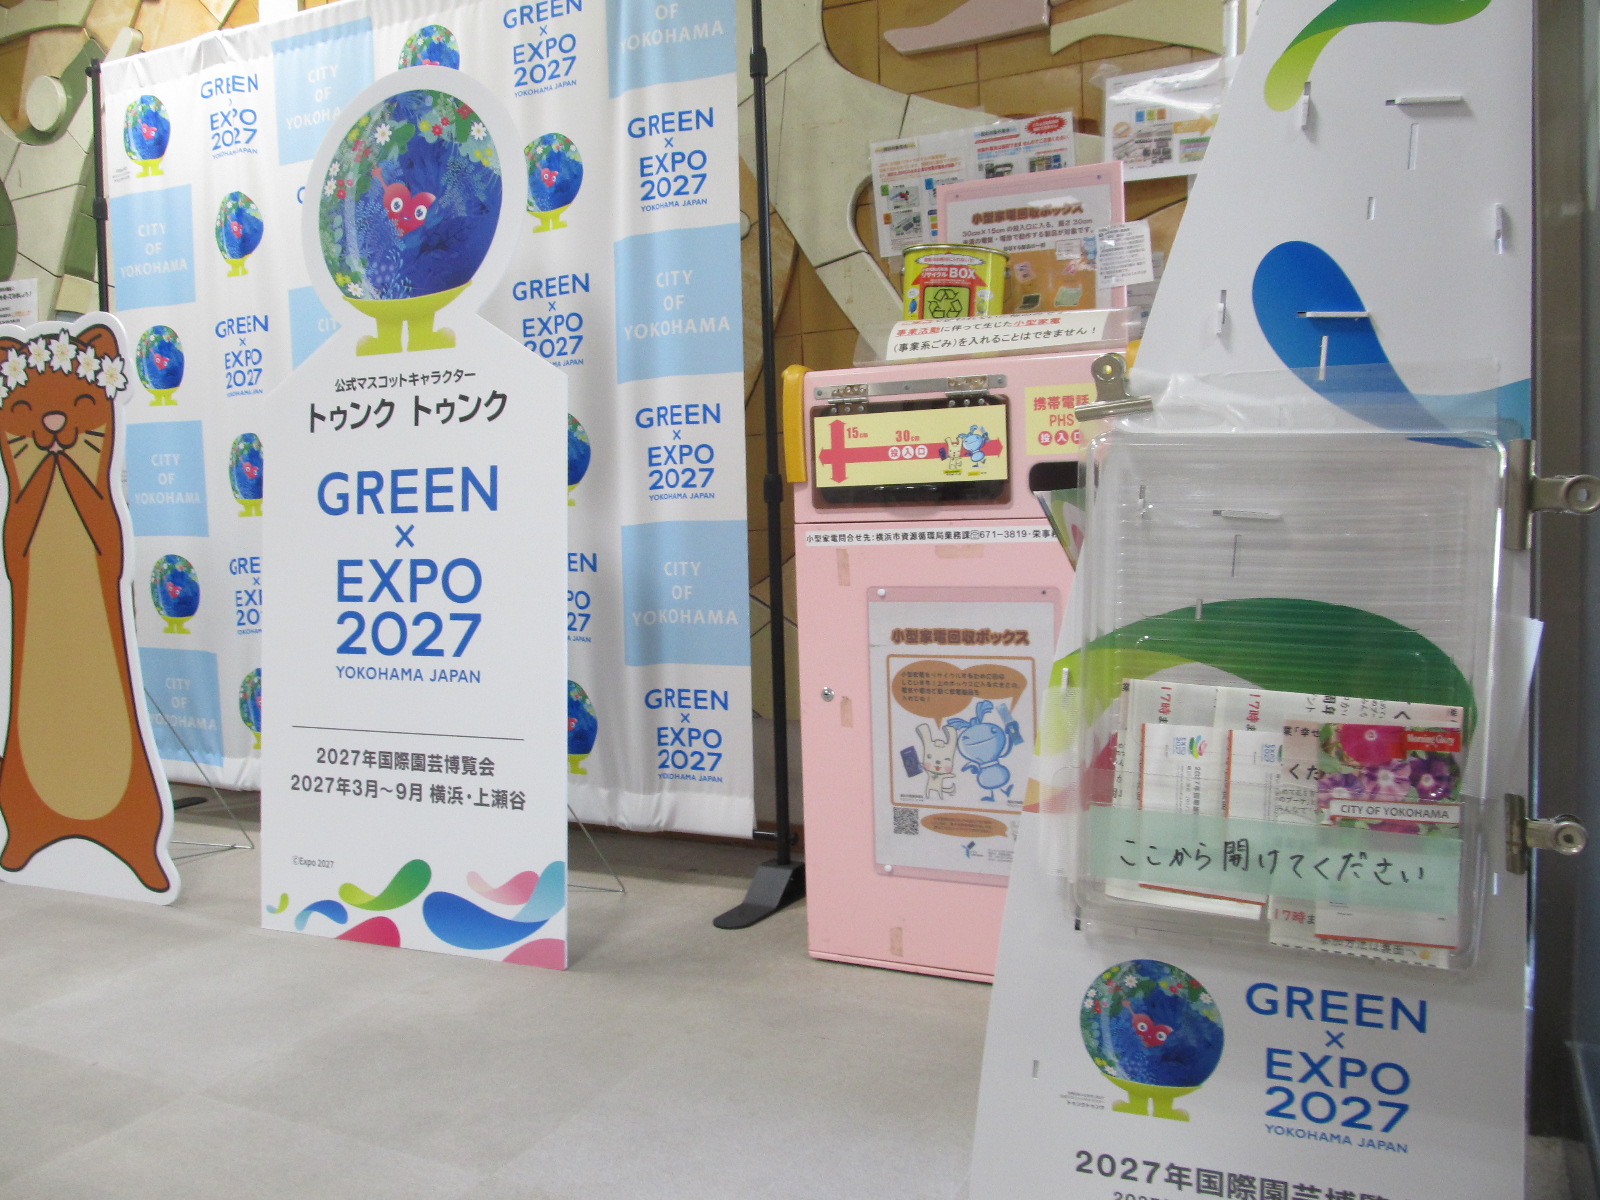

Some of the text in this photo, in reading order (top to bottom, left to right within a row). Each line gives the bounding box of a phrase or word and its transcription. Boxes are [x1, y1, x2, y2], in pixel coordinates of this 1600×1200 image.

[503, 0, 582, 29] GREEN
[655, 3, 679, 20] OF
[619, 19, 725, 54] YOKOHAMA
[513, 33, 577, 65] EXPO
[307, 64, 339, 83] CITY
[514, 55, 577, 87] 2027
[201, 73, 258, 99] GREEN
[315, 86, 332, 102] OF
[514, 80, 577, 98] YOKOHAMA JAPAN
[285, 106, 342, 130] YOKOHA
[627, 107, 715, 138] GREEN
[639, 149, 708, 178] EXPO
[640, 173, 708, 201] 2027
[640, 198, 708, 212] YOKOHAMA JAPAN
[137, 221, 167, 238] CITY
[144, 242, 162, 256] OF
[119, 260, 188, 279] YOKOHAMA
[655, 270, 693, 288] CITY
[949, 267, 977, 279] BOX
[512, 272, 590, 301] GREEN
[663, 294, 685, 311] OF
[215, 314, 269, 338] GREEN
[318, 317, 337, 332] CIT
[522, 312, 584, 338] EXPO
[624, 316, 731, 341] YOKOHAMA
[225, 348, 263, 369] EXPO
[563, 359, 584, 367] JAPAN
[226, 368, 263, 389] 2027
[334, 369, 477, 393] 公式マスコットキャラクター
[310, 389, 508, 433] トゥンク トゥンク
[1034, 394, 1090, 411] 携帯電話
[635, 403, 721, 429] GREEN
[1049, 413, 1075, 427] PHS
[846, 426, 869, 439] 15cm
[895, 429, 920, 443] 30cm
[151, 453, 181, 466] CITY
[648, 443, 715, 467] EXPO
[889, 446, 927, 459] 投入口
[158, 473, 176, 485] OF
[648, 467, 715, 491] 2027
[135, 492, 200, 505] YOKOHAMA
[317, 465, 498, 516] GREEN
[648, 492, 715, 501] YOKOHAMA JAPAN
[229, 556, 261, 575] GRE
[663, 561, 702, 577] CITY
[337, 557, 483, 604] EXPO
[671, 585, 693, 600] OF
[236, 608, 262, 626] 20
[567, 612, 591, 632] 27
[632, 608, 739, 626] YOKOHAMA
[336, 611, 482, 658] 2027
[891, 627, 1030, 646] 小型家電回収ボックス
[166, 677, 191, 690] CITY
[335, 665, 481, 684] YOKOHAMA JAPAN
[171, 696, 188, 708] OF
[644, 688, 729, 711] GREEN
[657, 727, 722, 749] EXPO
[316, 747, 495, 778] 2027年国際園芸博覧会
[657, 749, 723, 772] 2027
[698, 775, 723, 783] JAPAN
[1340, 804, 1449, 819] CITY OF YOKOHAMA
[317, 858, 334, 869] 2027
[1119, 838, 1424, 886] ここから開けてください
[1245, 981, 1427, 1034] GREEN
[1265, 1047, 1411, 1096] EXPO
[1264, 1085, 1410, 1134] 2027
[1264, 1123, 1409, 1154] YOKOHAMA JAPAN
